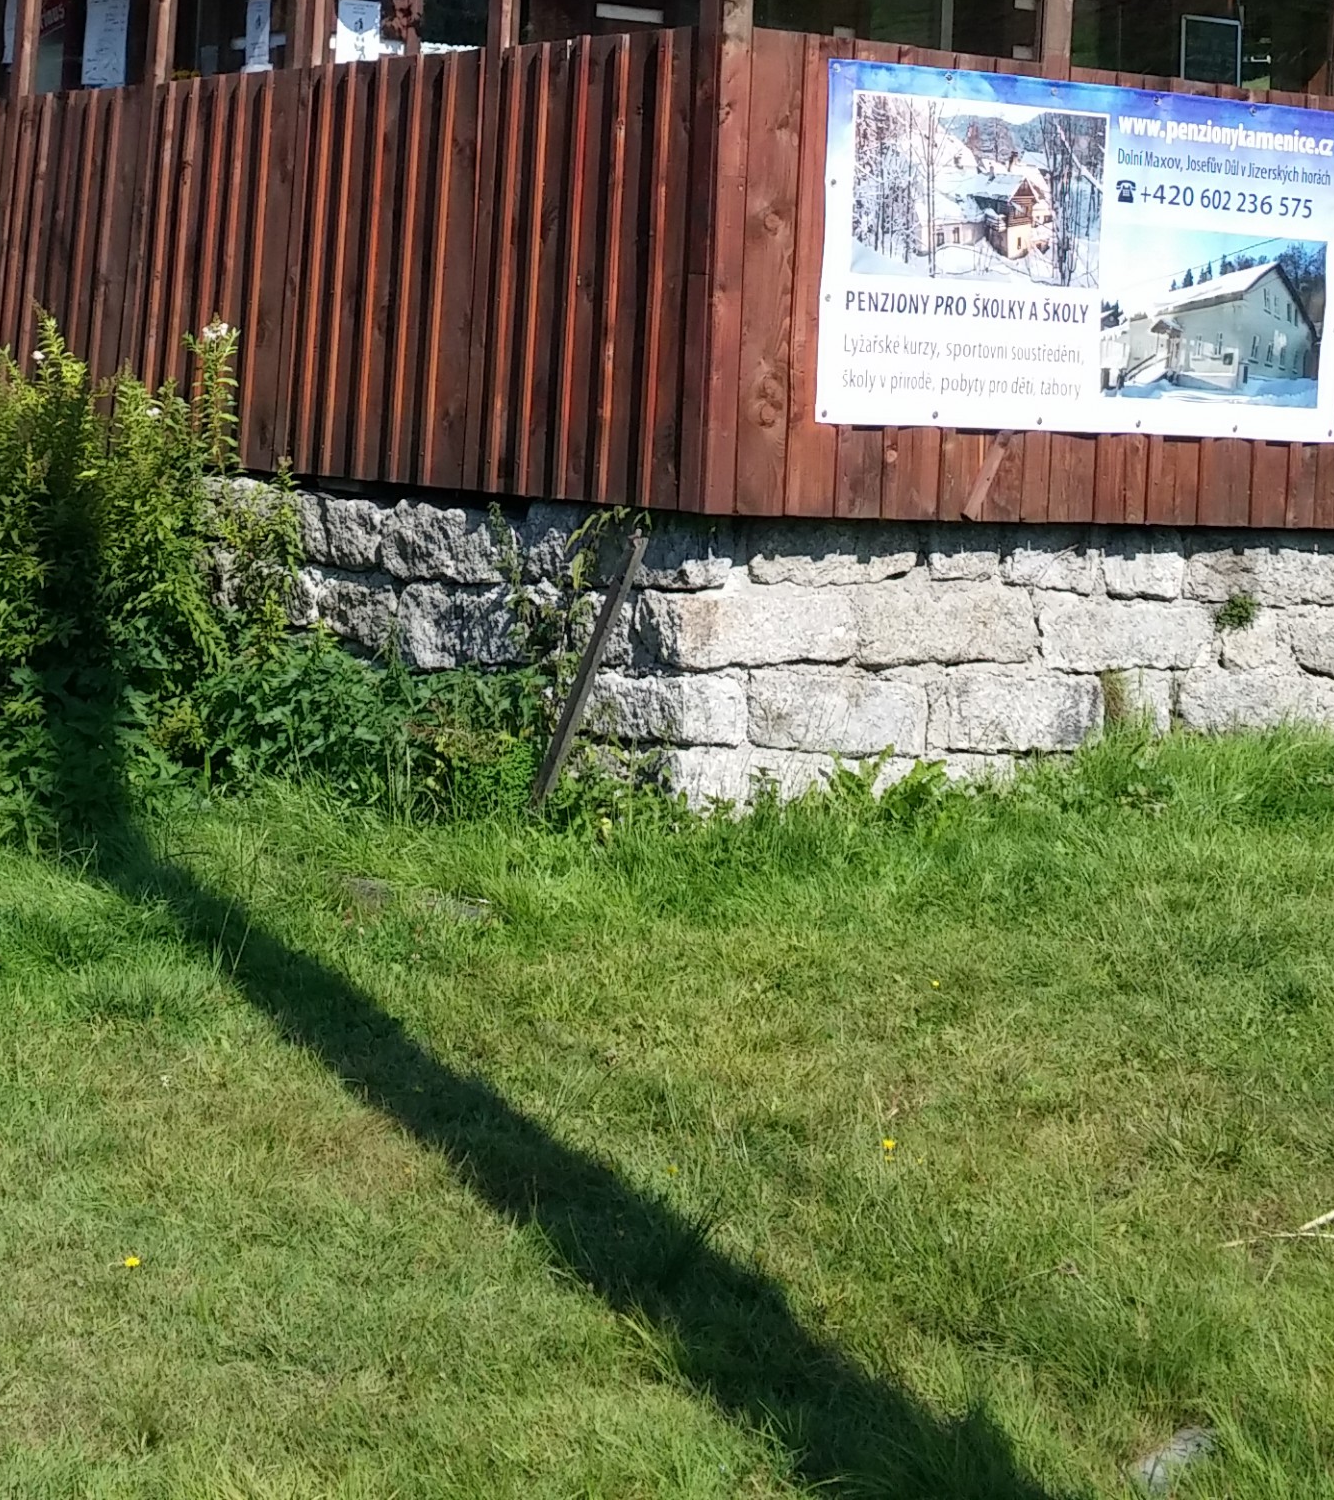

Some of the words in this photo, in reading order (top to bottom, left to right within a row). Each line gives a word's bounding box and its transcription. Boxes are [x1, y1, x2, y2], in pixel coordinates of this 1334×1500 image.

[1118, 115, 1334, 157] www.penzionykamenice.cz
[1117, 148, 1144, 167] Dolní
[1144, 152, 1184, 173] Maxov,
[1186, 154, 1223, 173] Josefův
[1224, 159, 1240, 176] Důl
[1241, 165, 1247, 176] v
[1247, 163, 1300, 185] Jizerských
[1301, 167, 1331, 186] horách
[1140, 183, 1194, 207] +420
[1200, 188, 1232, 211] 602
[1237, 192, 1273, 215] 236
[1279, 197, 1313, 219] 575
[845, 290, 930, 315] PENZIONY
[934, 295, 967, 316] PRO
[972, 293, 1025, 320] ŠKOLKY
[1028, 301, 1038, 321] A
[1042, 298, 1089, 324] ŠKOLY
[843, 333, 900, 357] Lyžařské
[903, 336, 940, 360] kurzy,
[842, 369, 876, 393] školy
[880, 374, 886, 388] v
[940, 374, 985, 397] pobyty
[989, 378, 1008, 397] pro
